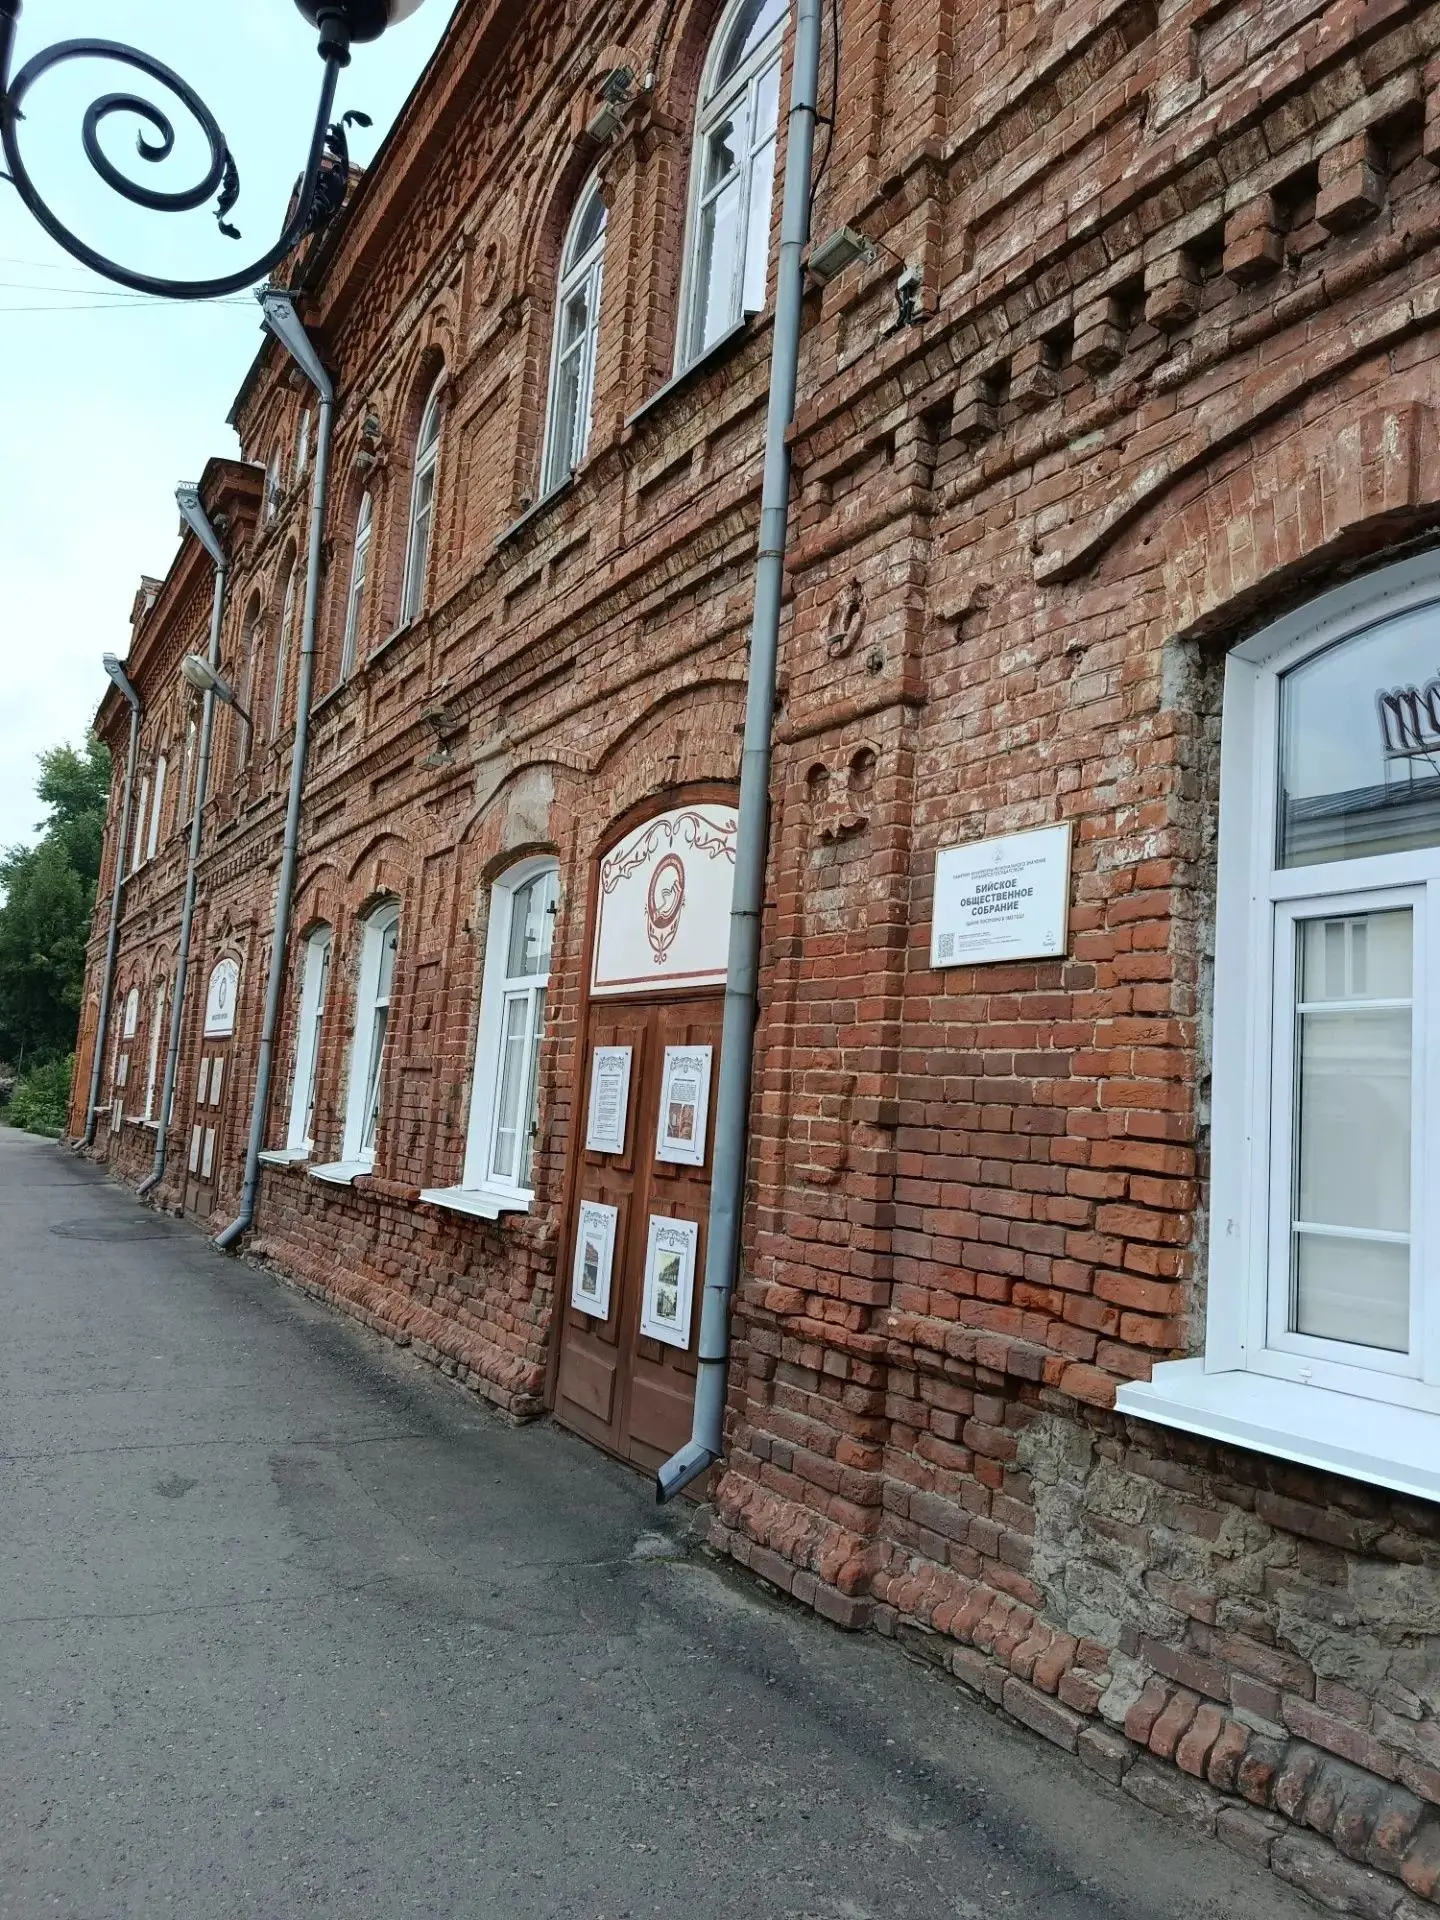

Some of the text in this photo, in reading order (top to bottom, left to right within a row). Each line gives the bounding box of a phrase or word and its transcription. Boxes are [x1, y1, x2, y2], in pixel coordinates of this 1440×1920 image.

[975, 878, 1017, 894] БИЙСКОЕ
[960, 887, 1033, 907] ОБЩЕСТВЕННОЕ
[971, 900, 1019, 916] СОБРАНИЕ
